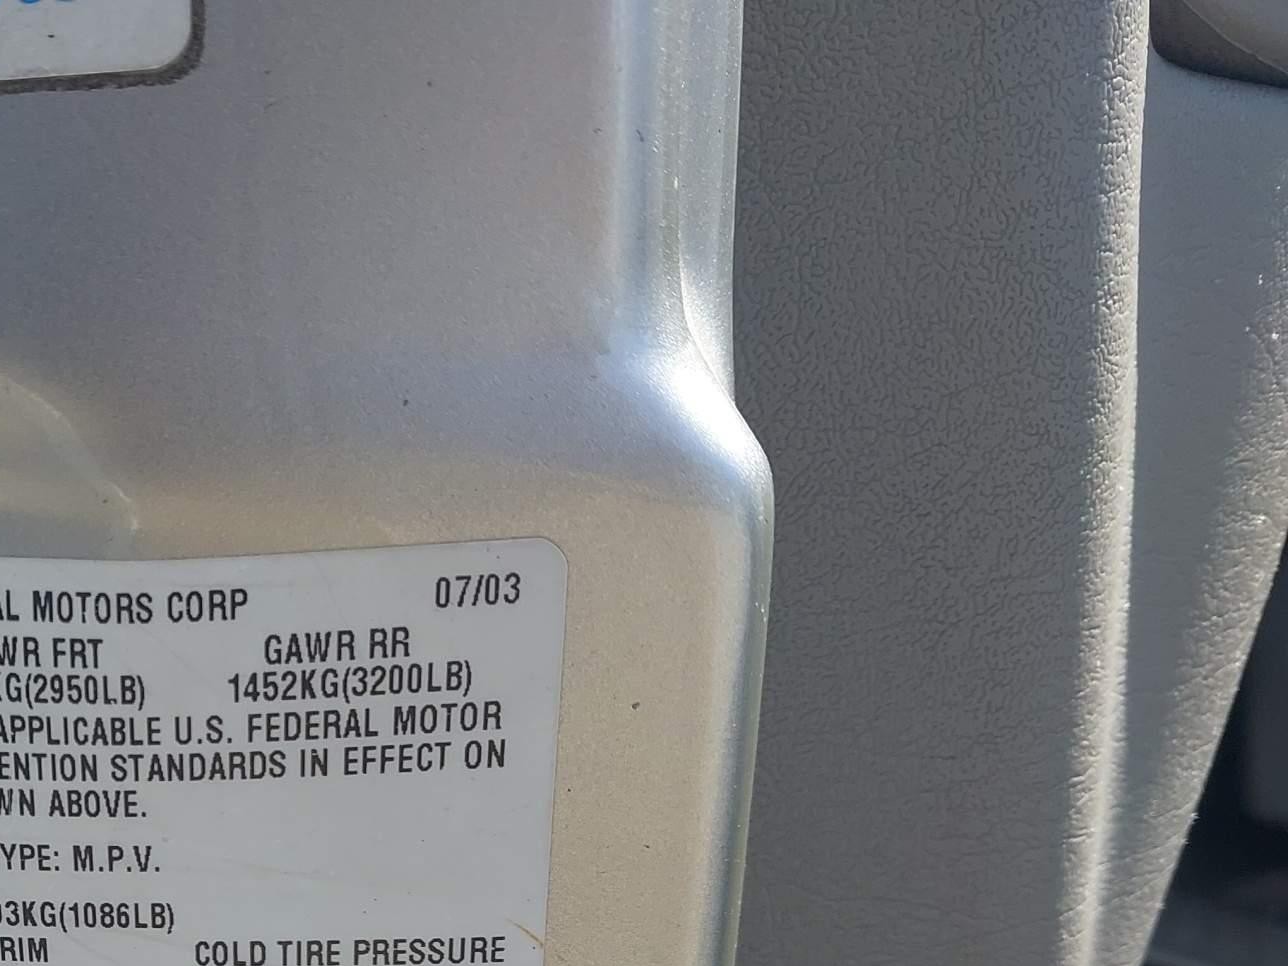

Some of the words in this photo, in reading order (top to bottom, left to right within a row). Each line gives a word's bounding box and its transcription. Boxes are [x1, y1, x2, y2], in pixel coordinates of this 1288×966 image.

[32, 590, 153, 624] MOTORS
[167, 588, 248, 623] CORP
[435, 572, 521, 608] 07/03
[52, 637, 103, 669] FRT
[264, 630, 355, 665] GAWR
[369, 626, 410, 659] RR
[228, 660, 472, 704] 1452KG(3200LB)
[175, 715, 232, 745] U.S.
[248, 708, 379, 743] FEDERAL
[393, 700, 501, 735] MOTOR
[110, 750, 286, 782] STANDARDS
[300, 748, 328, 777] IN
[344, 742, 452, 775] EFFECT
[464, 739, 505, 769] ON
[49, 789, 146, 818] ABOVE.
[72, 845, 160, 872] M.P.V.
[0, 937, 48, 962] RIM
[195, 941, 266, 966] COLD
[277, 940, 340, 966] TIRE
[354, 936, 505, 965] PRESSURE
